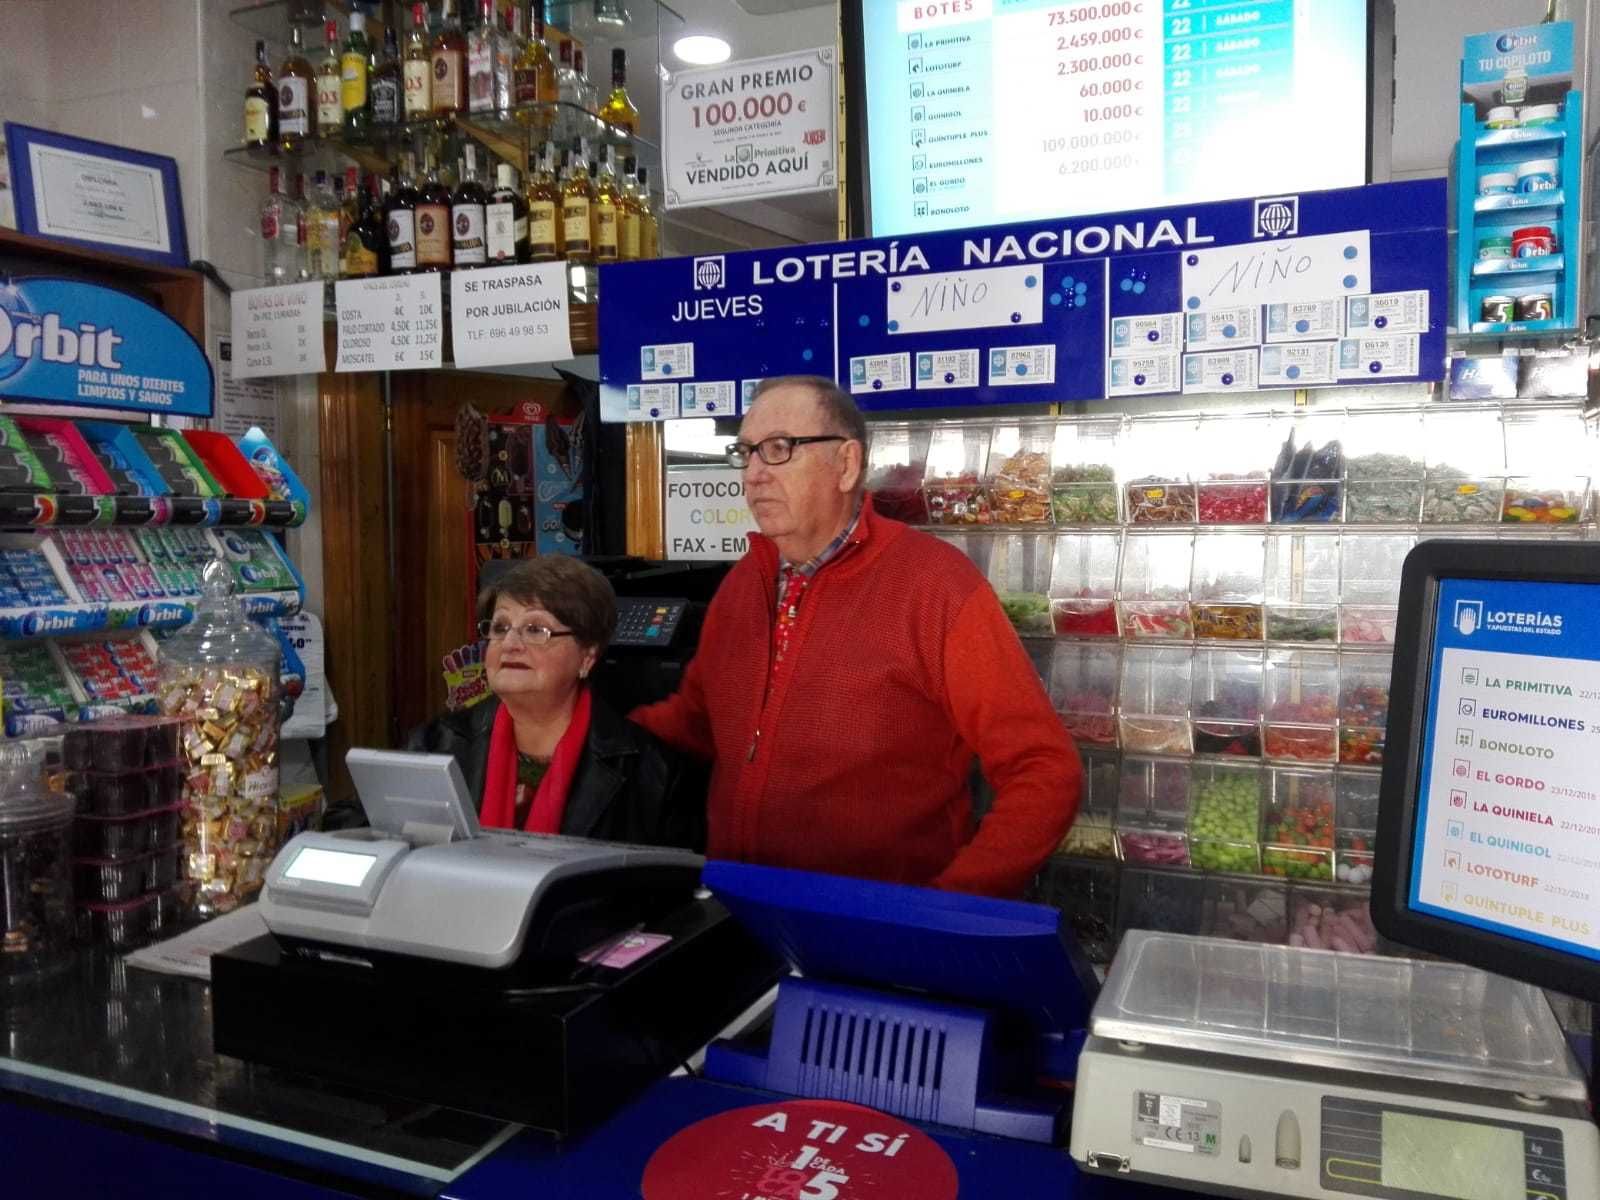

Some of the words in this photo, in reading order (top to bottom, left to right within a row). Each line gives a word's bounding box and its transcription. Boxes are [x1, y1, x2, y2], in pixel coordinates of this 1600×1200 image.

[914, 0, 973, 19] BOTES
[1172, 17, 1191, 36] 22
[1479, 59, 1493, 72] TU
[1495, 51, 1551, 70] COPILOTO
[681, 77, 734, 100] GRAN
[741, 65, 813, 90] PREMIO
[692, 92, 793, 128] 100.000
[686, 163, 759, 185] VENDIDO
[765, 152, 809, 175] AQUÍ
[753, 241, 930, 285] LOTERÍA
[963, 217, 1214, 266] NACIONAL
[1209, 245, 1312, 297] NIÑO
[465, 281, 479, 292] SE
[482, 275, 542, 291] TRASPASA
[466, 306, 489, 318] POR
[492, 298, 560, 316] JUBILACIÓN
[672, 295, 763, 322] JUEVES
[911, 277, 988, 318] NIÑO
[1497, 304, 1509, 323] 5
[1536, 300, 1548, 320] 5
[537, 324, 549, 335] 53
[78, 369, 108, 384] PARA
[111, 374, 140, 387] UNOS
[142, 377, 185, 394] DIENTES
[78, 384, 126, 400] LIMPIOS
[129, 389, 135, 401] Y
[138, 392, 174, 406] SANOS
[673, 538, 706, 553] FAX
[722, 538, 750, 553] EM
[1487, 611, 1563, 627] LOTERÍAS
[1485, 677, 1501, 688] LA
[1506, 680, 1573, 697] PRIMITIVA
[1482, 708, 1585, 731] EUROMILLONES
[1479, 739, 1554, 759] BONOLOTO
[1476, 770, 1490, 782] EL
[1495, 773, 1545, 791] GORDO
[1473, 801, 1488, 813] LA
[1492, 805, 1554, 826] QUINIELA
[1470, 832, 1484, 844] EL
[1487, 836, 1552, 858] QUINIGOL
[1467, 862, 1539, 888] LOTOTURF
[1463, 894, 1545, 923] QUINTUPLE
[1552, 916, 1591, 935] PLUS
[752, 1112, 788, 1132] A
[807, 1119, 848, 1144] TI
[855, 1133, 911, 1157] SÍ
[1205, 1134, 1216, 1144] M
[790, 1145, 820, 1170] 1
[814, 1156, 832, 1164] DE
[1531, 1143, 1543, 1155] kg
[809, 1162, 845, 1175] CADA
[800, 1171, 850, 1200] 5
